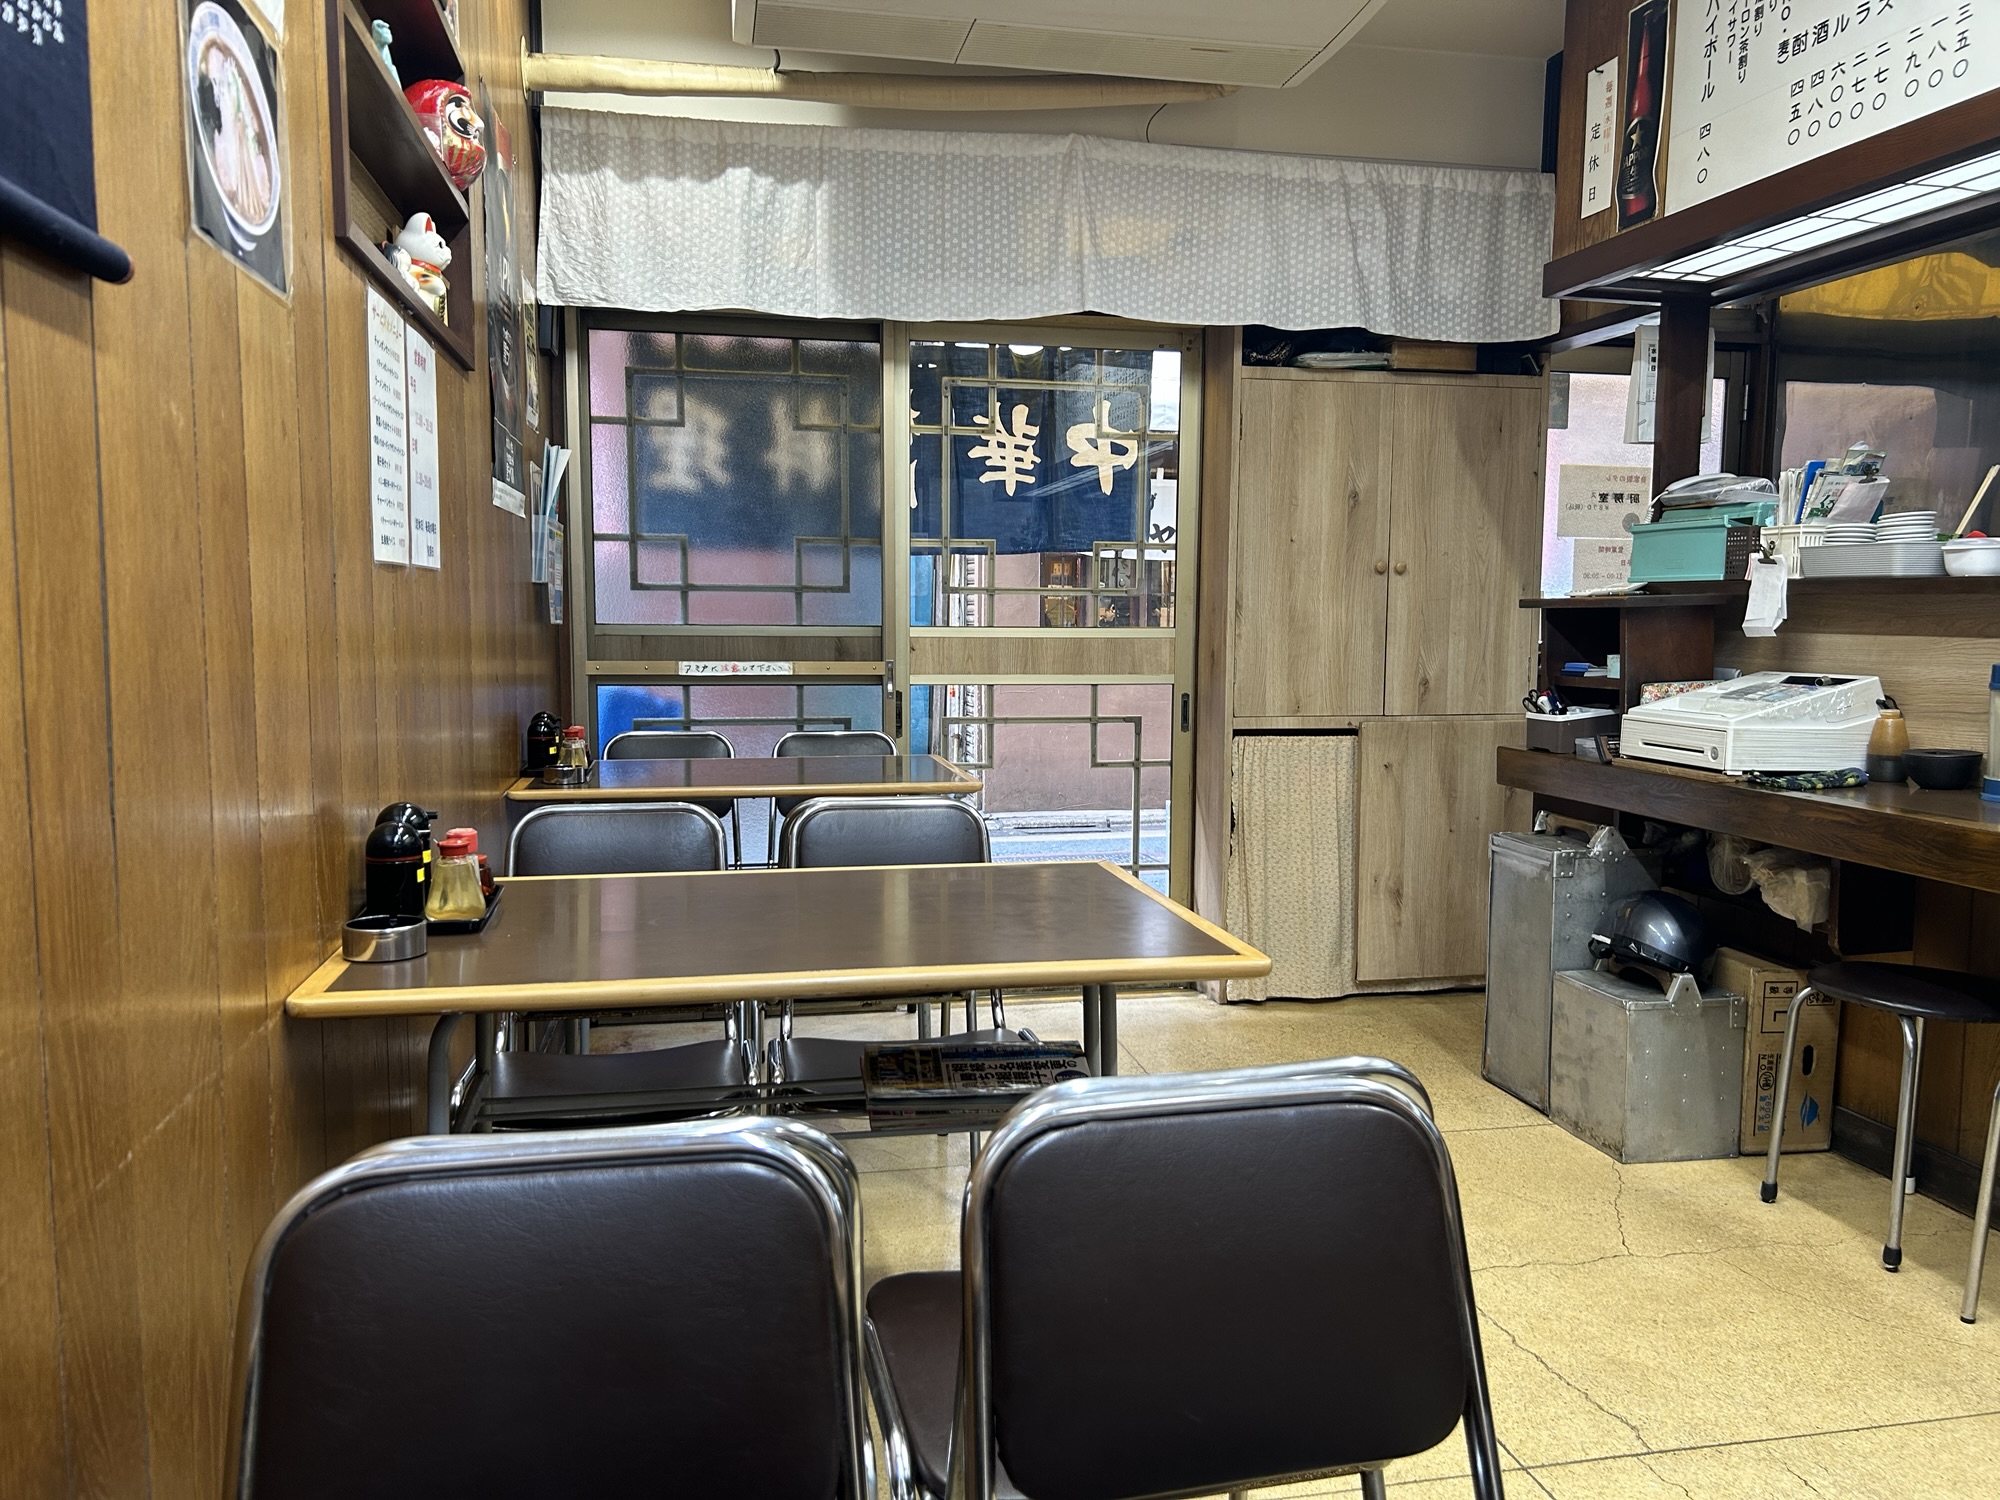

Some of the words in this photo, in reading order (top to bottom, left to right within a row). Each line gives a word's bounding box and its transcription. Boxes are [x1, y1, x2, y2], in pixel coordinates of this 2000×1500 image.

[1905, 27, 1924, 98] 二九〇
[1928, 17, 1949, 88] 一八〇
[1953, 3, 1974, 78] 三五〇
[1808, 69, 1825, 137] 四八〇
[1829, 62, 1846, 129] 六〇〇
[1850, 52, 1868, 120] 二七〇
[1873, 42, 1891, 111] 二七〇
[1788, 79, 1804, 146] 四五〇
[1588, 122, 1601, 202] 定休日
[1697, 122, 1711, 184] 四八〇
